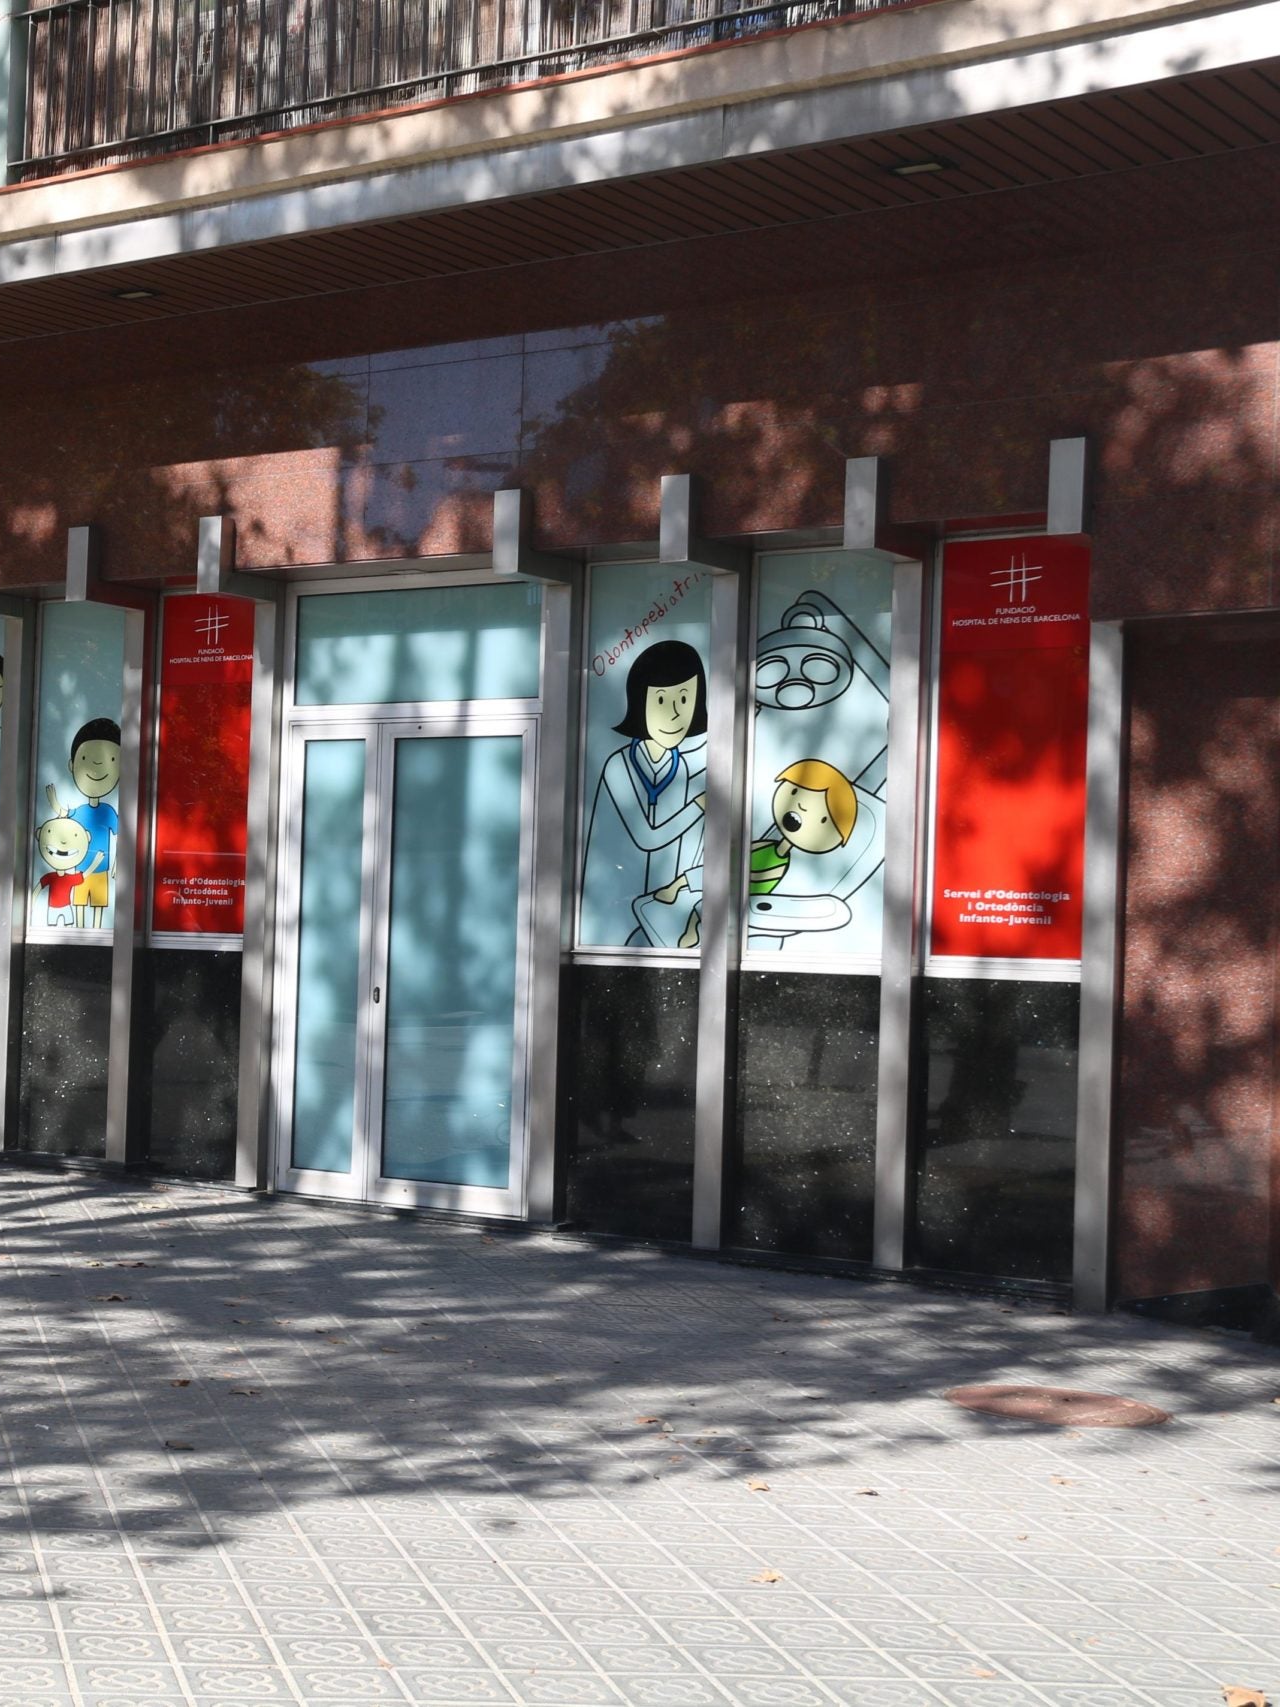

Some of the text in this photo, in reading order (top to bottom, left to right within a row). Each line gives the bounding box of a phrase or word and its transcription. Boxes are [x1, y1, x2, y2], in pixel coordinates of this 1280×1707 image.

[995, 605, 1036, 615] FUNDACIÓ
[952, 619, 986, 627] HOSPITAL
[988, 617, 999, 625] DE
[1033, 614, 1080, 622] BARCELONA
[162, 877, 187, 885] Servei
[183, 887, 228, 896] Ortodòncia
[943, 888, 1070, 903] Servei d'Odontologia
[975, 902, 1043, 912] Ortodòncia
